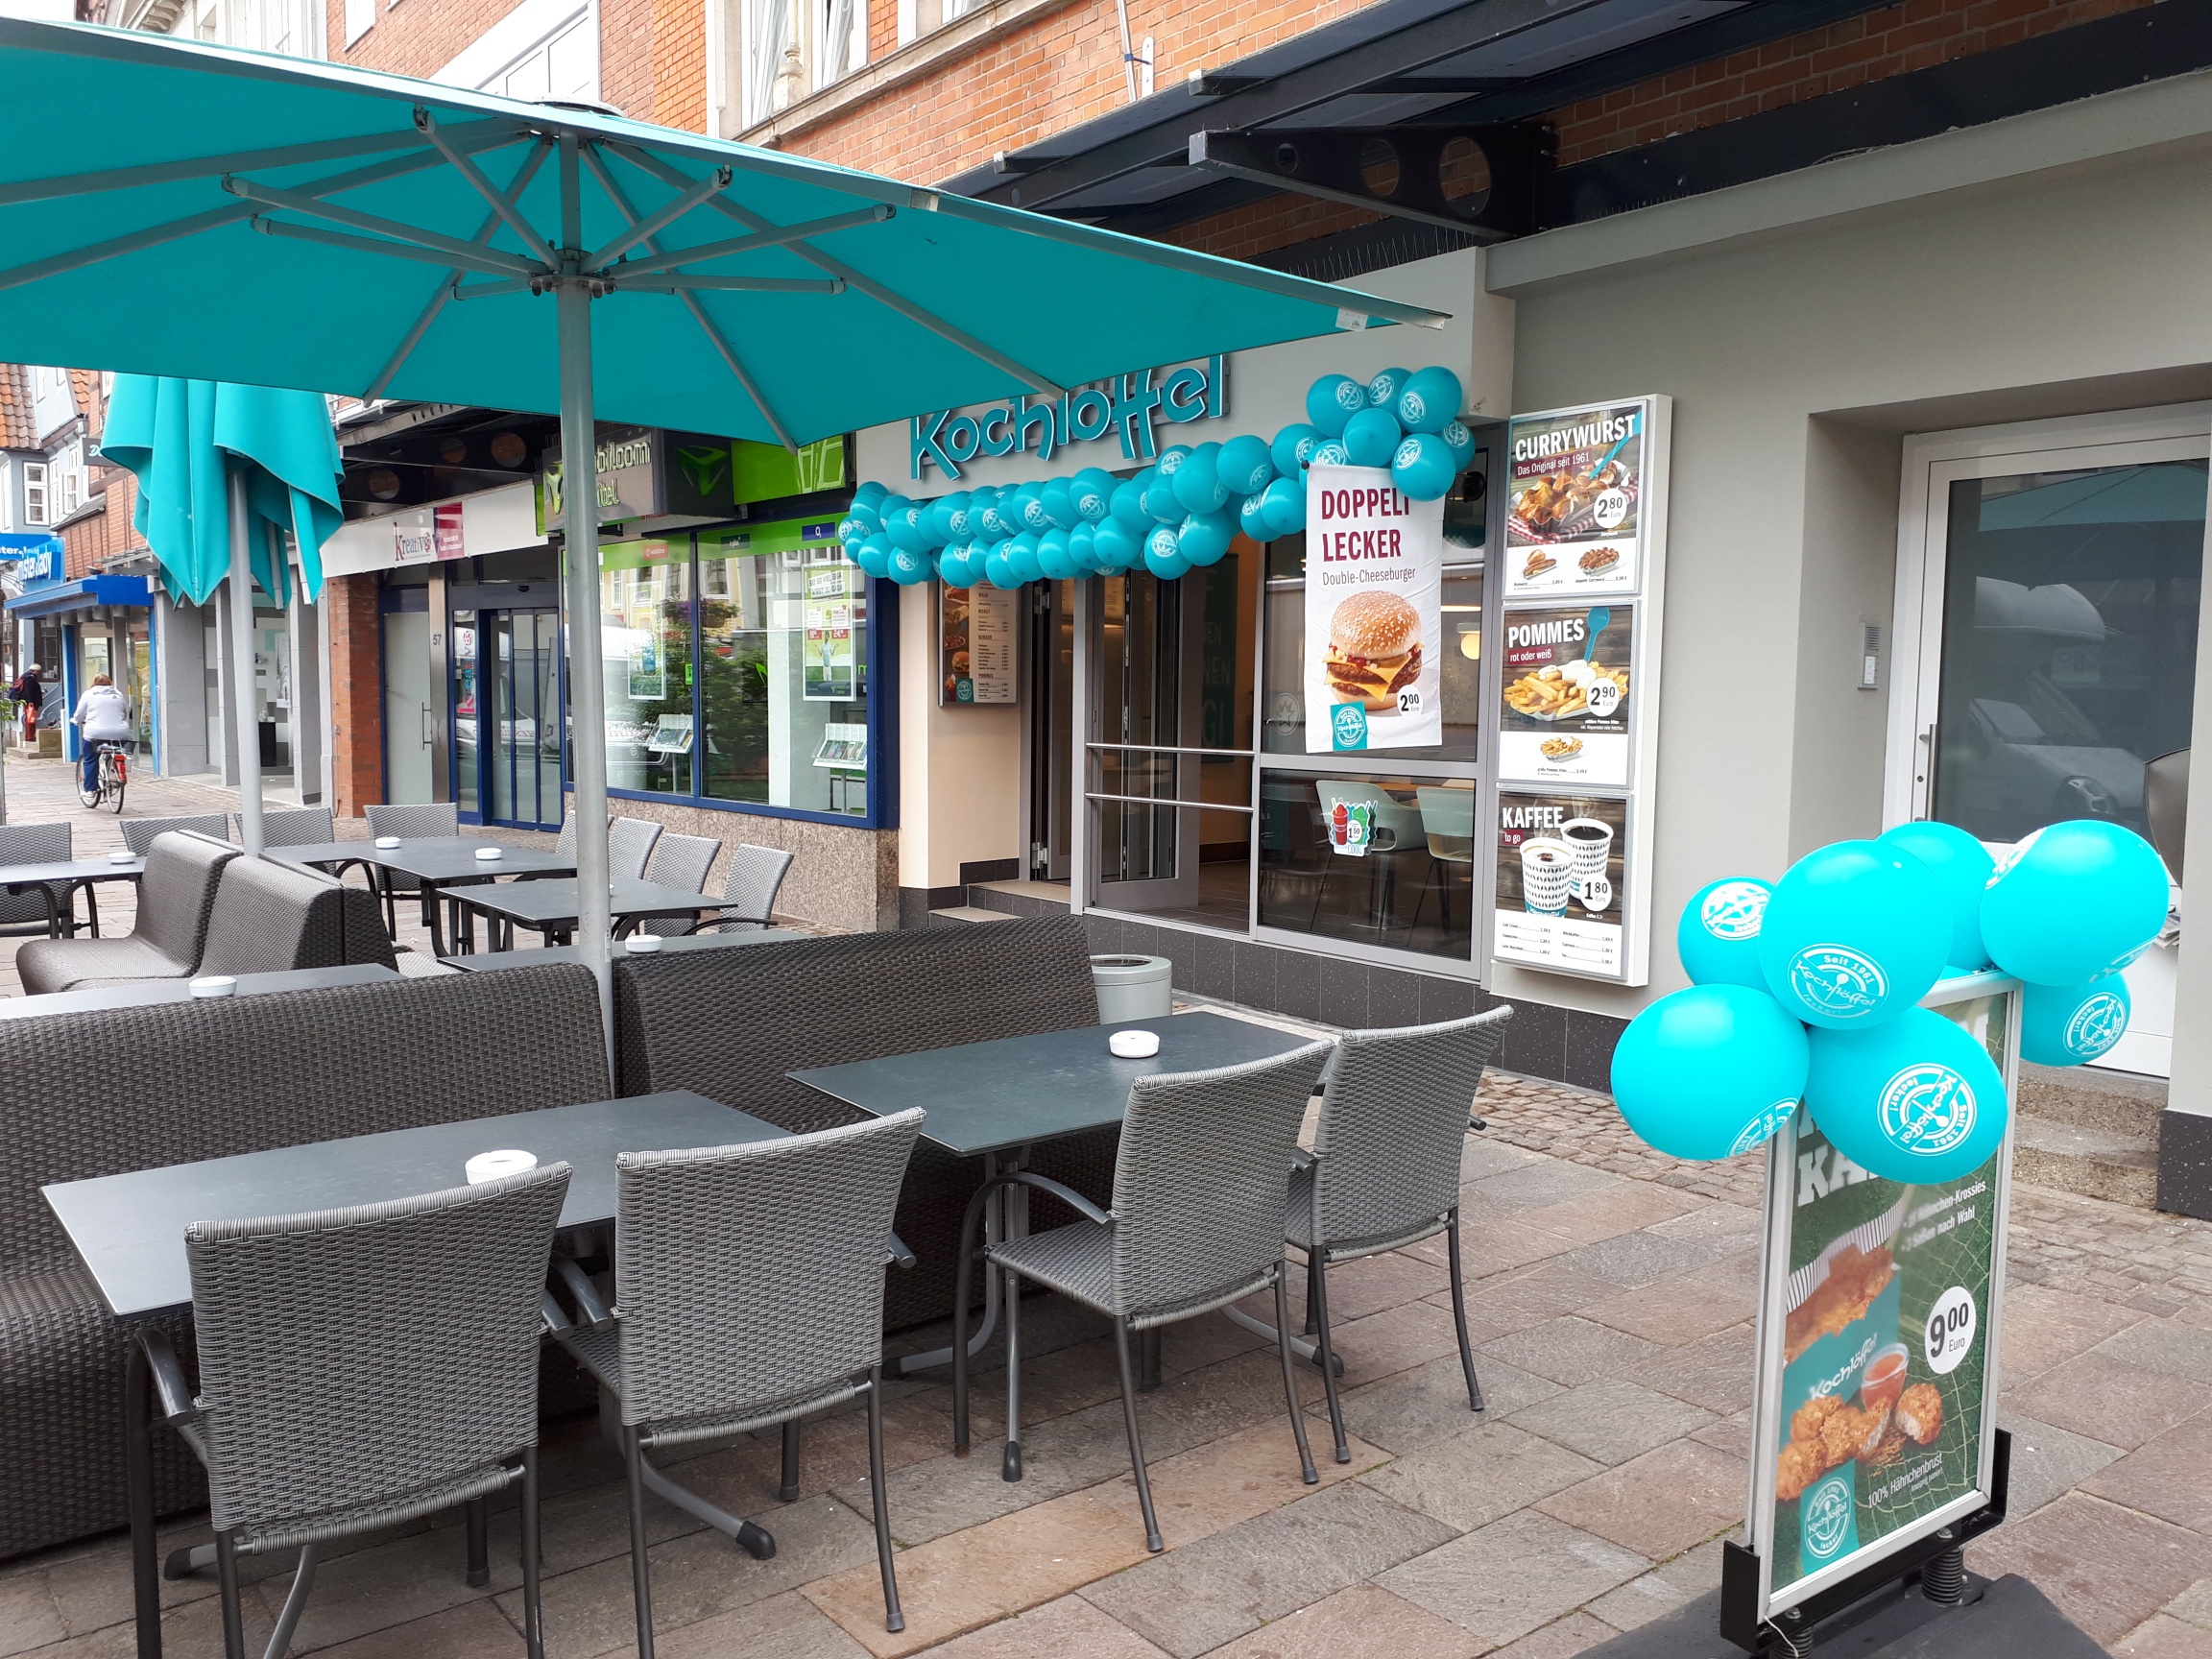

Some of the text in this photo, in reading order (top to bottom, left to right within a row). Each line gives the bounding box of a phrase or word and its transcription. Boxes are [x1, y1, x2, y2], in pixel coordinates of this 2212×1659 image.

[1515, 414, 1636, 462] CURRYWURST
[1517, 452, 1590, 476] Das Original seit 1961
[1322, 529, 1402, 563] LECKER
[1322, 567, 1416, 586] Double-Cheeseburger
[432, 634, 443, 646] 57
[1507, 617, 1585, 649] POMMES
[1509, 649, 1552, 662] rot oder weiß
[1502, 806, 1564, 829] KAFFEE
[1504, 832, 1521, 845] to go
[1794, 959, 1877, 1006] Kochlöffel
[1823, 954, 1876, 985] Seit 1961
[1899, 1073, 1959, 1144] Kochlöffel
[1932, 1104, 1967, 1147] Seit 1961
[1937, 1214, 1955, 1236] nach
[1957, 1204, 1976, 1226] Wahl
[1948, 1339, 1965, 1353] Euro
[1867, 1452, 1943, 1509] 100% Hähnchenbrust
[1807, 1503, 1847, 1535] Kochlöffel
